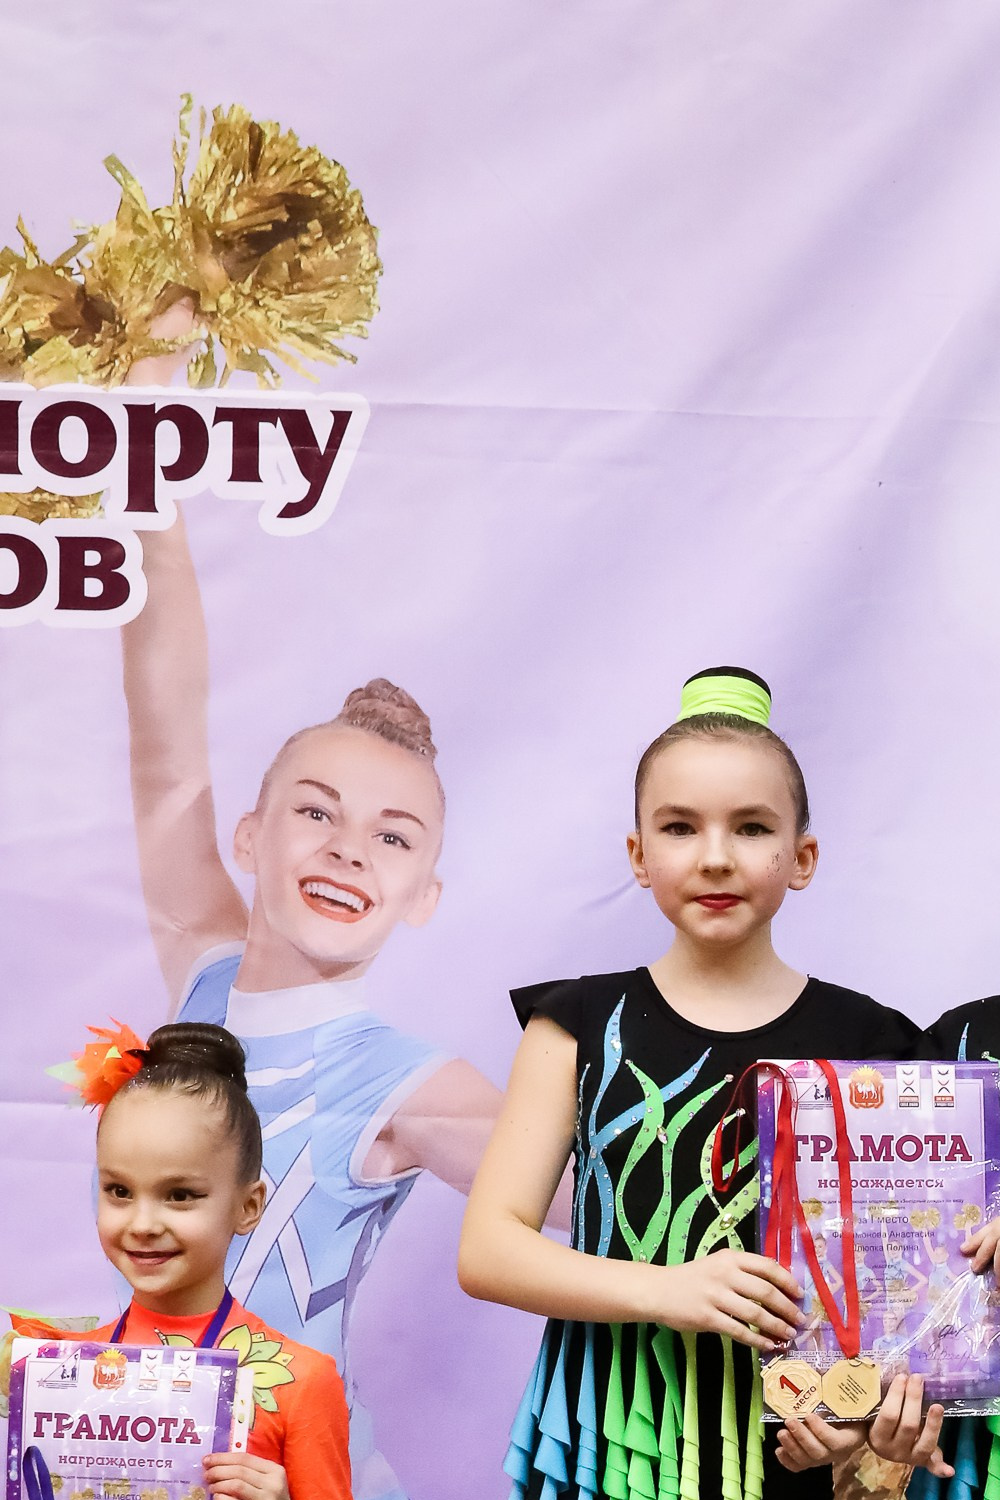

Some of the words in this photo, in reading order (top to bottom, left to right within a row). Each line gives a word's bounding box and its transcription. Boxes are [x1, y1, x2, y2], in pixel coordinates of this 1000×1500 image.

[817, 1178, 945, 1192] нараждается
[877, 1216, 909, 1225] место
[886, 1243, 919, 1253] Полина
[779, 1374, 804, 1399] 1
[33, 1411, 202, 1445] ГРАМОТА
[58, 1454, 173, 1469] награждается
